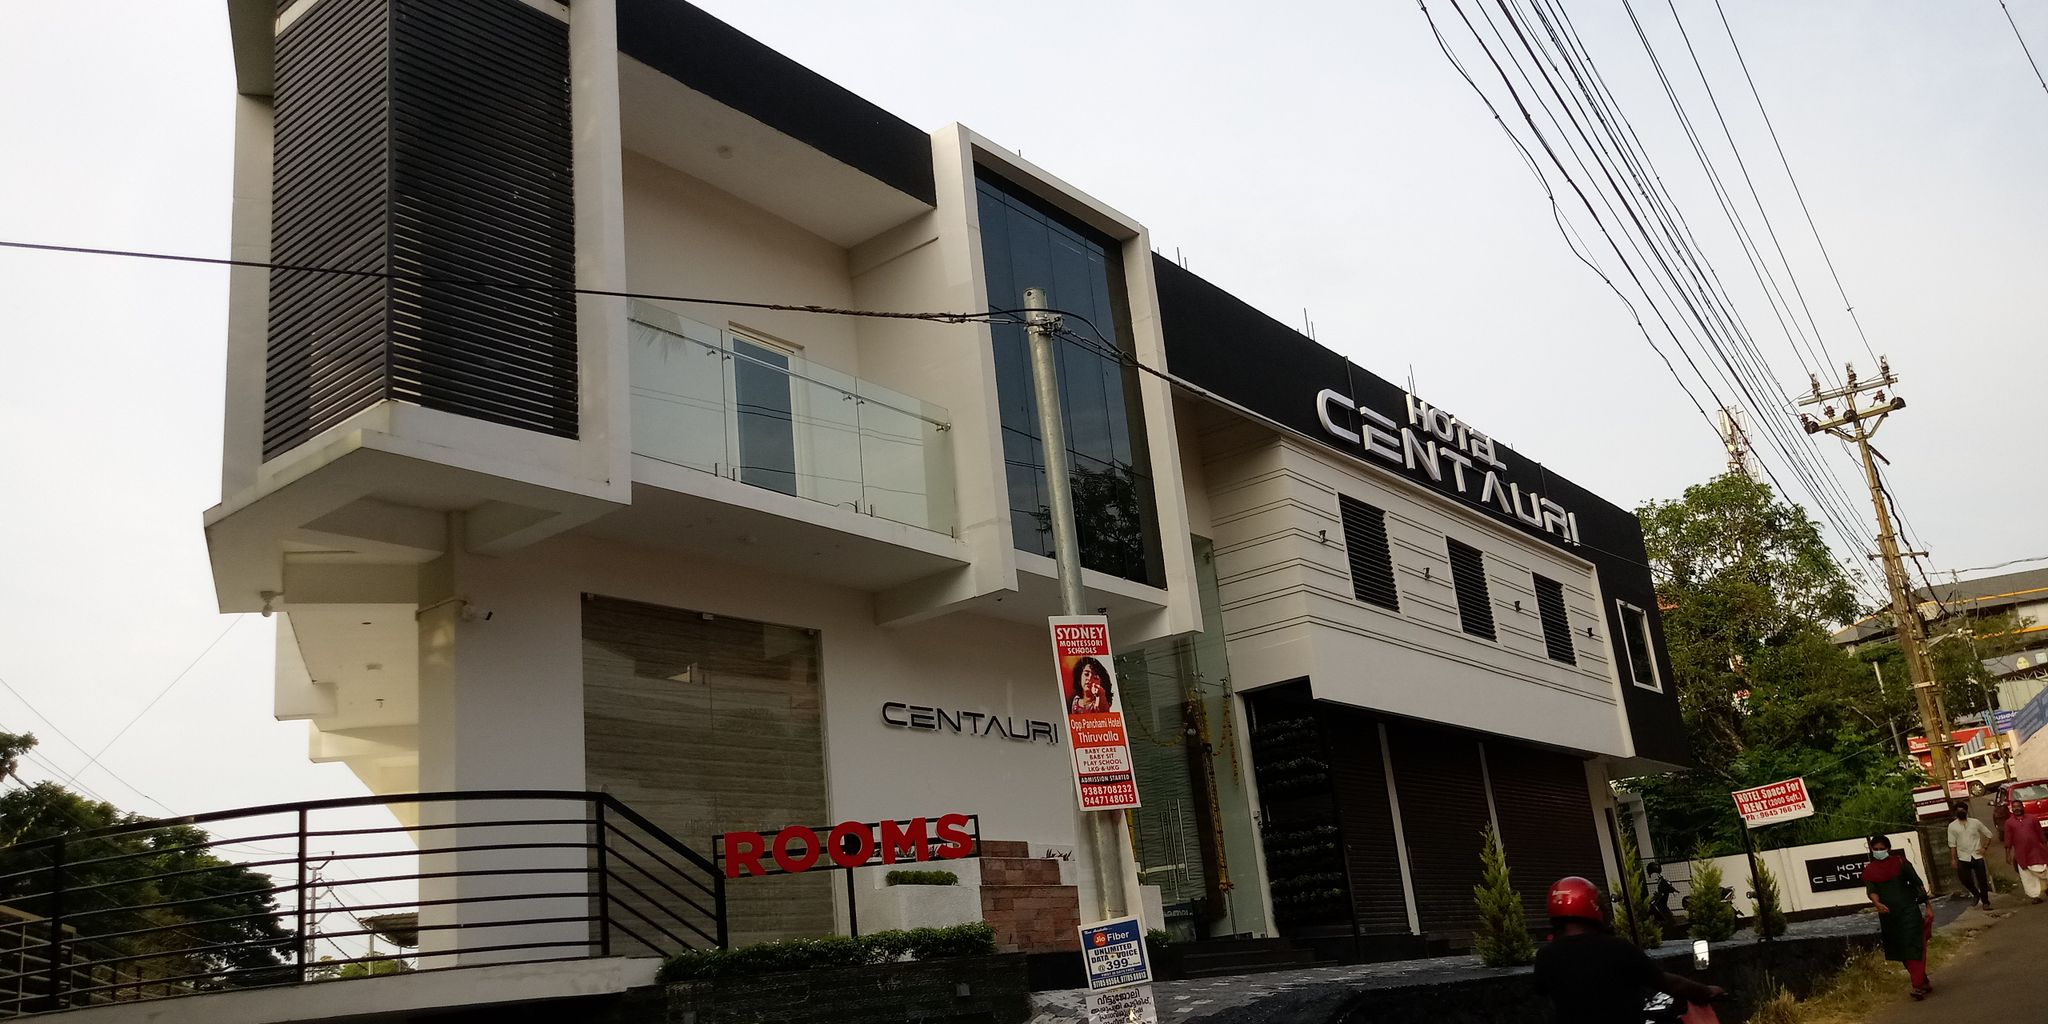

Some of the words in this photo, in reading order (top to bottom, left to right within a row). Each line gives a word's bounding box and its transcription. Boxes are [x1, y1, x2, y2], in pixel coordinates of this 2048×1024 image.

[1406, 393, 1507, 471] HOTEL
[1317, 388, 1580, 547] CENTAURI
[1056, 627, 1104, 640] SYDNEY
[882, 701, 1059, 745] CENTAURI
[1108, 718, 1121, 728] Hotel
[1078, 731, 1119, 743] Thiruvalla
[1083, 784, 1132, 795] 9388708232
[1736, 790, 1762, 803] HOTEL
[1760, 786, 1786, 799] Space
[1786, 782, 1799, 792] For
[1084, 794, 1134, 805] 9447148015
[1742, 800, 1768, 813] RENT
[1760, 809, 1778, 819] 9645
[724, 814, 974, 879] ROOMS
[1813, 872, 1862, 884] CENT
[1095, 935, 1106, 943] Jio
[1107, 932, 1130, 942] Fiber
[1094, 943, 1132, 955] UNLIMITED
[1091, 955, 1109, 963] DATA
[1116, 949, 1137, 959] VOICE
